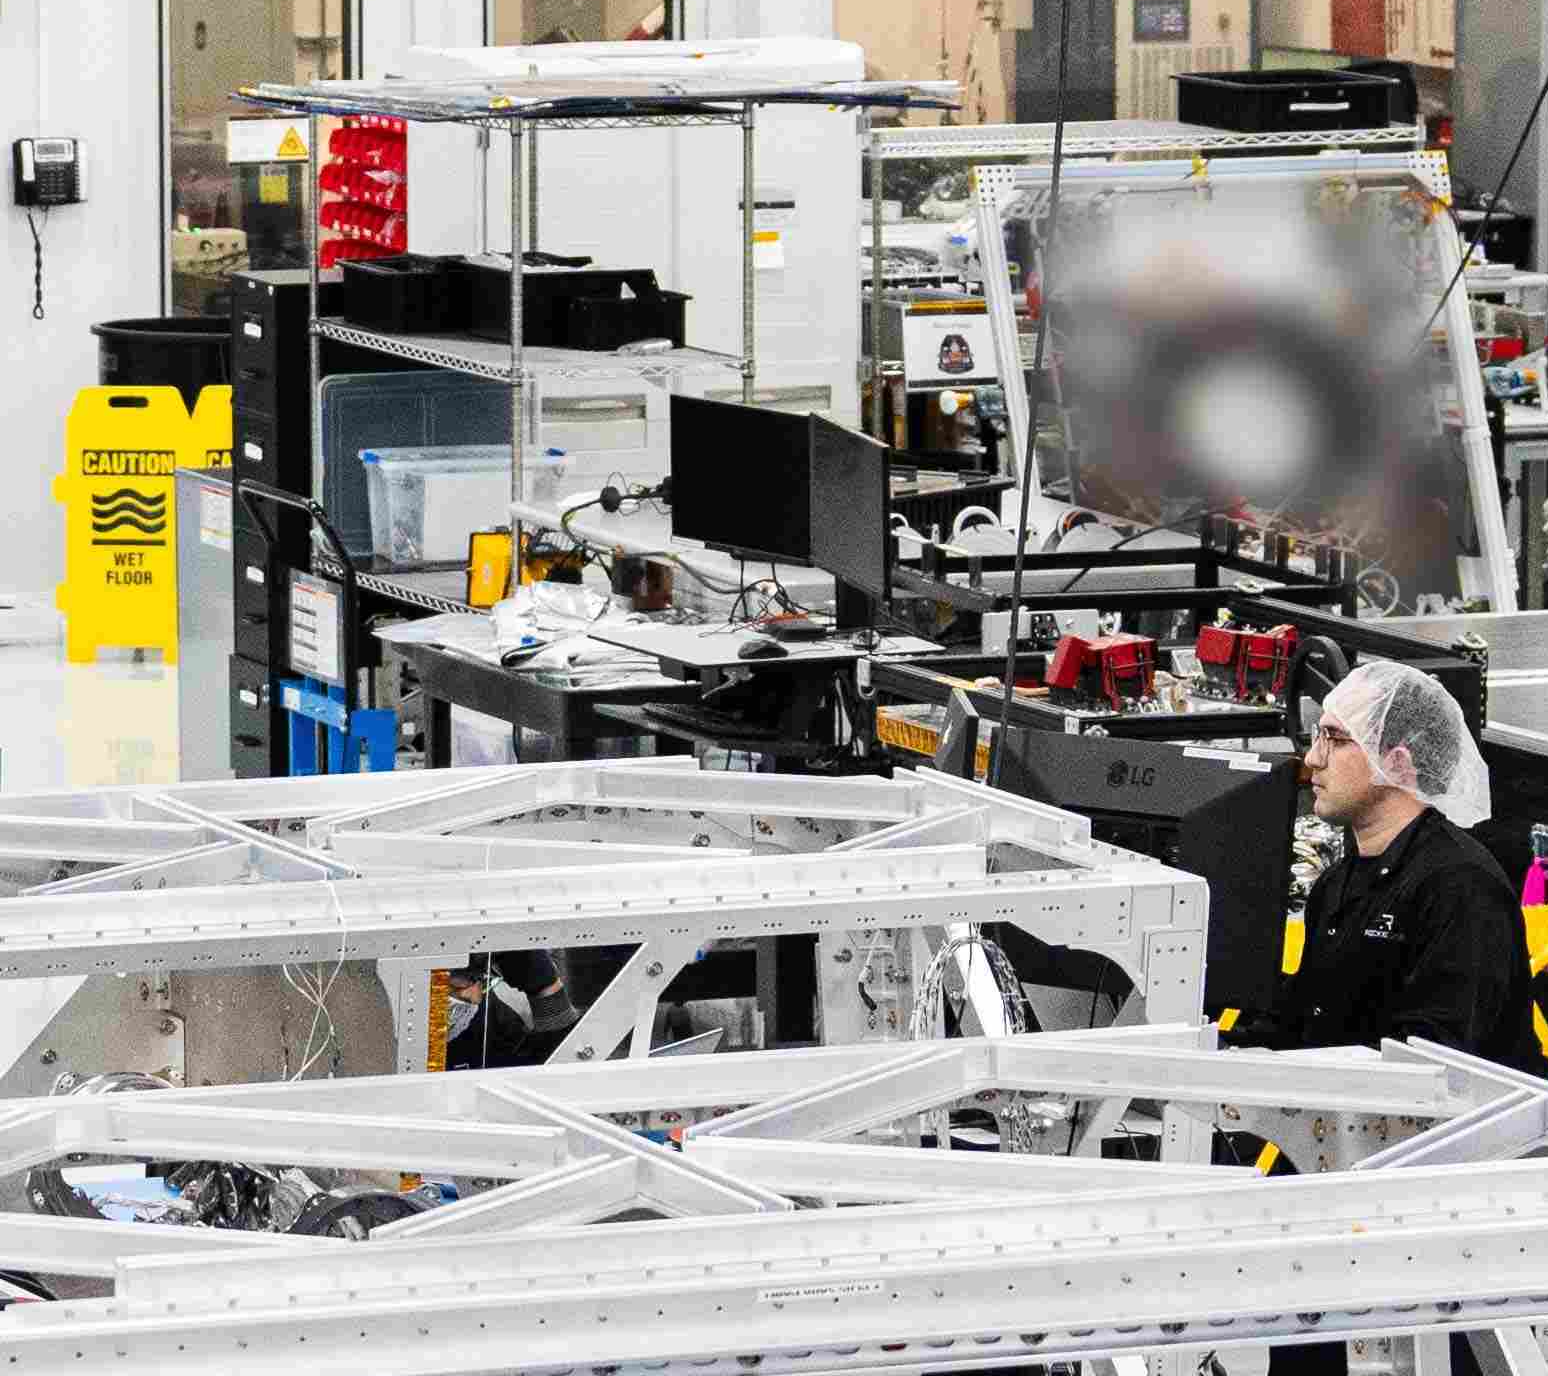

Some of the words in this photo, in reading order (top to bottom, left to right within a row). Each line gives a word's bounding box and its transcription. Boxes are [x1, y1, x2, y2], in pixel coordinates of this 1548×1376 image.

[83, 451, 175, 474] CAUTION
[113, 552, 145, 567] WET
[106, 571, 153, 585] FLOOR
